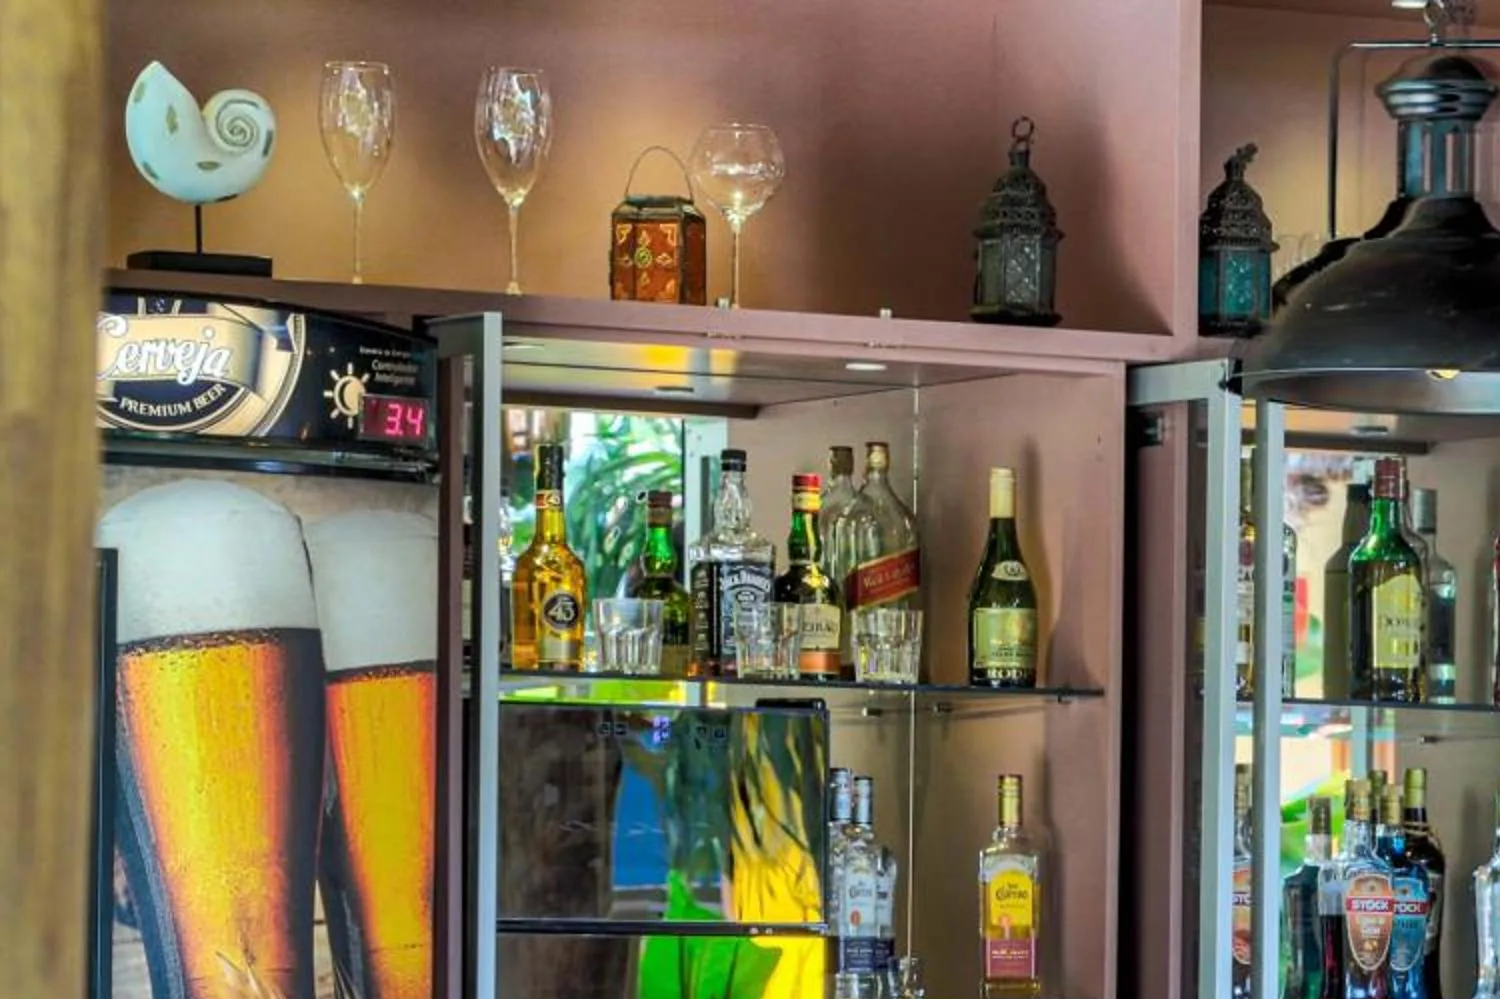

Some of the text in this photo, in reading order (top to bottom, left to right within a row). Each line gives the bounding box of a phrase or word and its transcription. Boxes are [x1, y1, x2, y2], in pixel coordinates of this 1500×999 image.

[120, 383, 227, 417] PREMIUM BEER
[1351, 899, 1389, 911] STOCK
